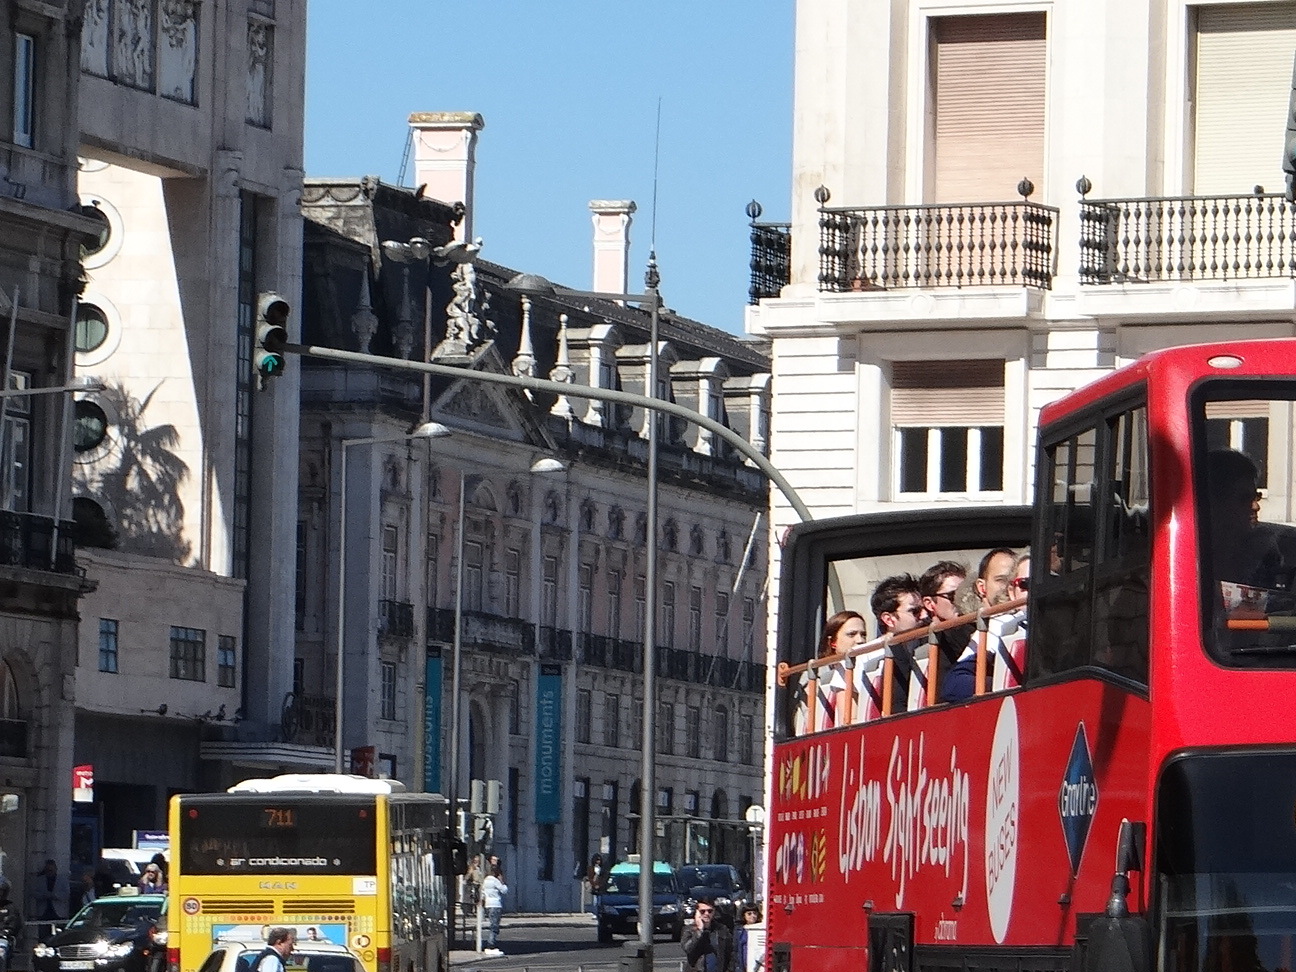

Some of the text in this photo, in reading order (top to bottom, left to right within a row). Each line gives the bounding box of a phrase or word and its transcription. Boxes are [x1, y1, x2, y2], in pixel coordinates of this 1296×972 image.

[991, 738, 1014, 819] NEW
[264, 808, 295, 826] 711
[838, 730, 970, 910] Lisbon Sightseeing
[249, 856, 328, 867] condicionado
[988, 801, 1017, 897] BUSES
[258, 881, 298, 890] MAN
